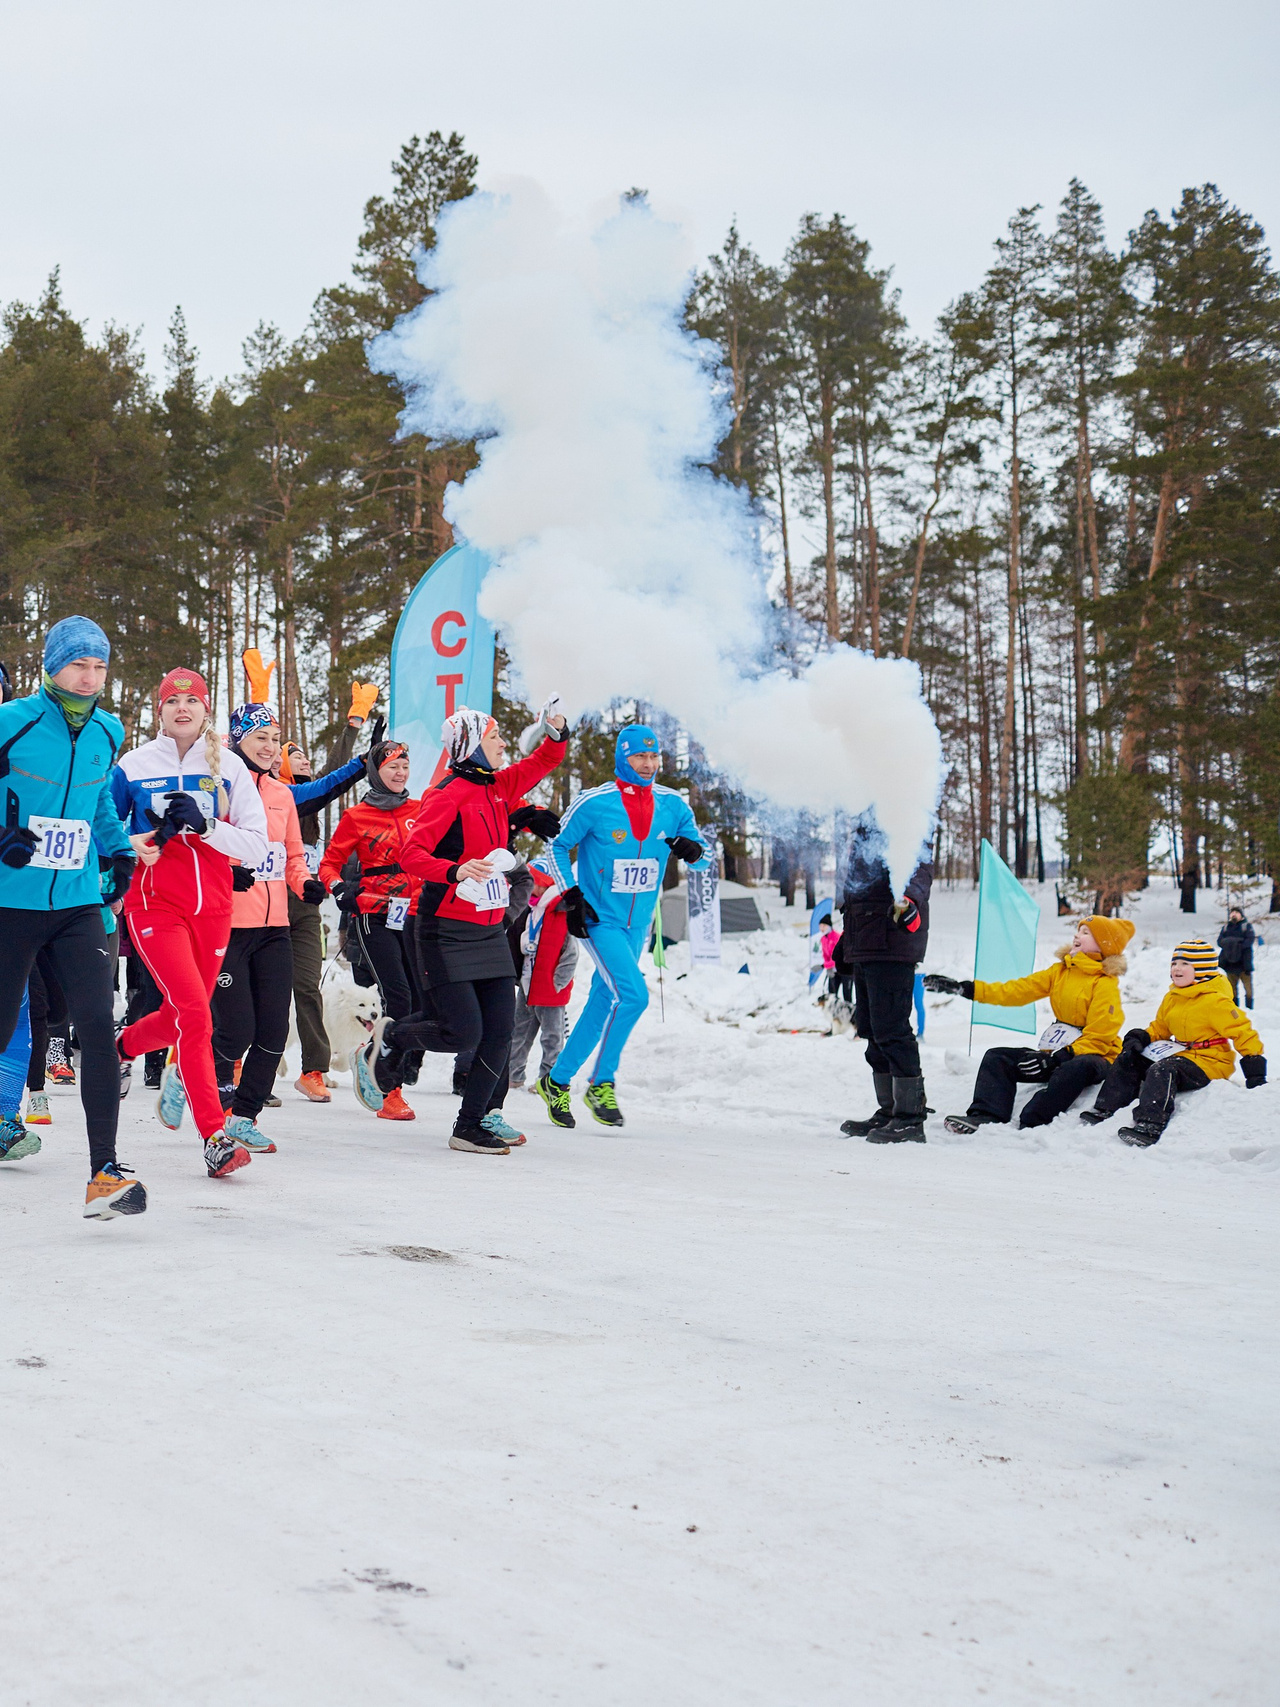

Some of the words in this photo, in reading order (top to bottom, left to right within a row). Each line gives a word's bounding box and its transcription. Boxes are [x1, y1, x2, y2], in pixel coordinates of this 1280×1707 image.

[44, 830, 75, 859] 181
[623, 867, 648, 886] 178
[486, 878, 501, 901] 111
[1048, 1029, 1067, 1044] 21
[1151, 1043, 1174, 1055] 20
